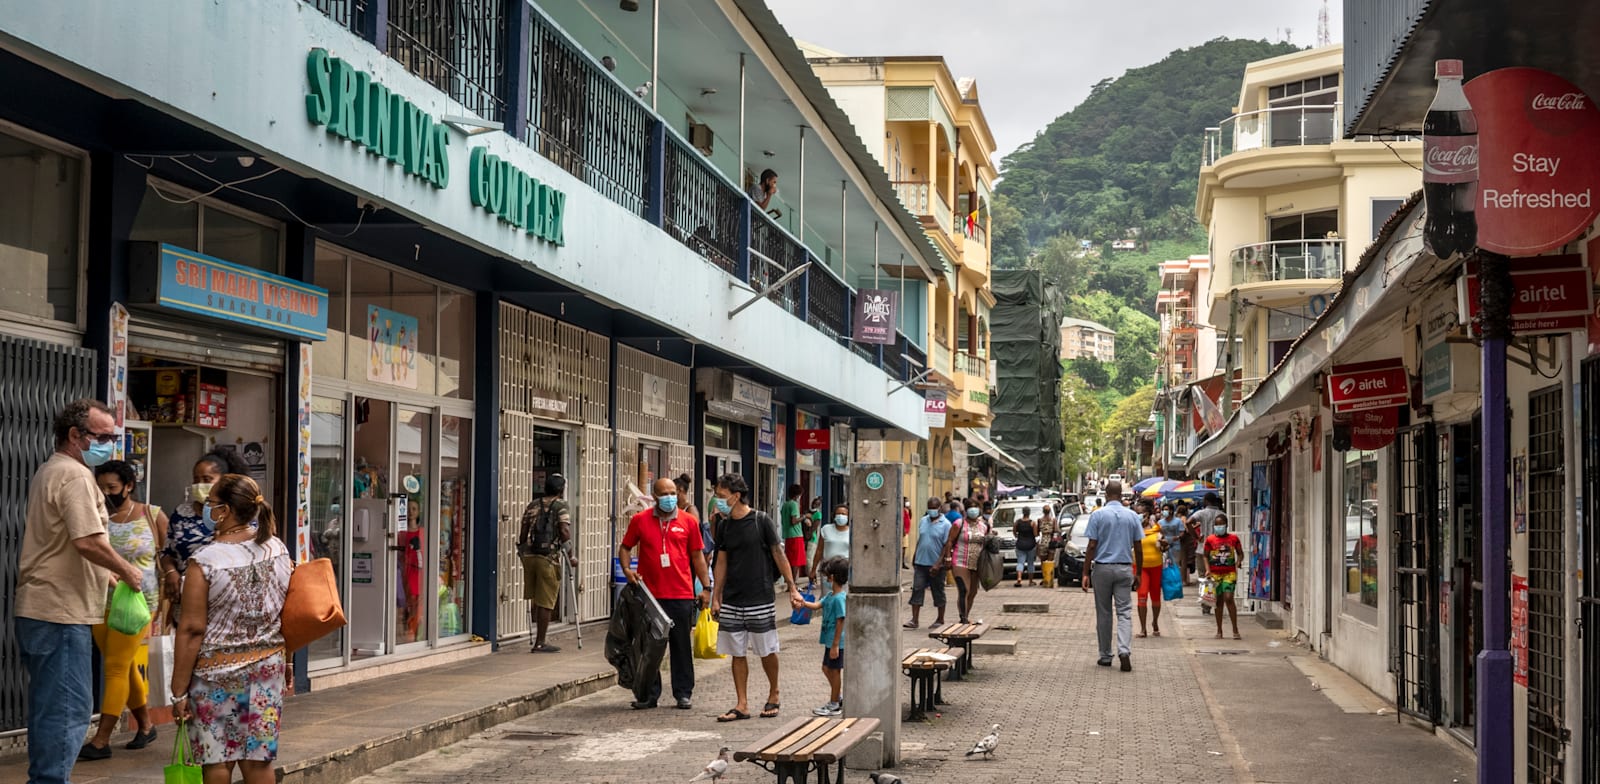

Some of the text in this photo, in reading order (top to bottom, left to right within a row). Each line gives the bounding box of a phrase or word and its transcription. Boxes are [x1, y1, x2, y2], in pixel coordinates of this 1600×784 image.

[1532, 93, 1586, 110] Coca-Cola
[306, 47, 566, 247] SRINIVAS COMPLEX
[1512, 152, 1560, 176] Stay
[1483, 188, 1591, 209] Refreshed
[414, 244, 420, 261] 7
[175, 259, 319, 318] SRI MAHA VISHNU
[1519, 284, 1567, 303] airtel
[207, 294, 292, 326] SNACK BOX
[1358, 378, 1387, 391] airtel
[926, 400, 945, 409] FLO
